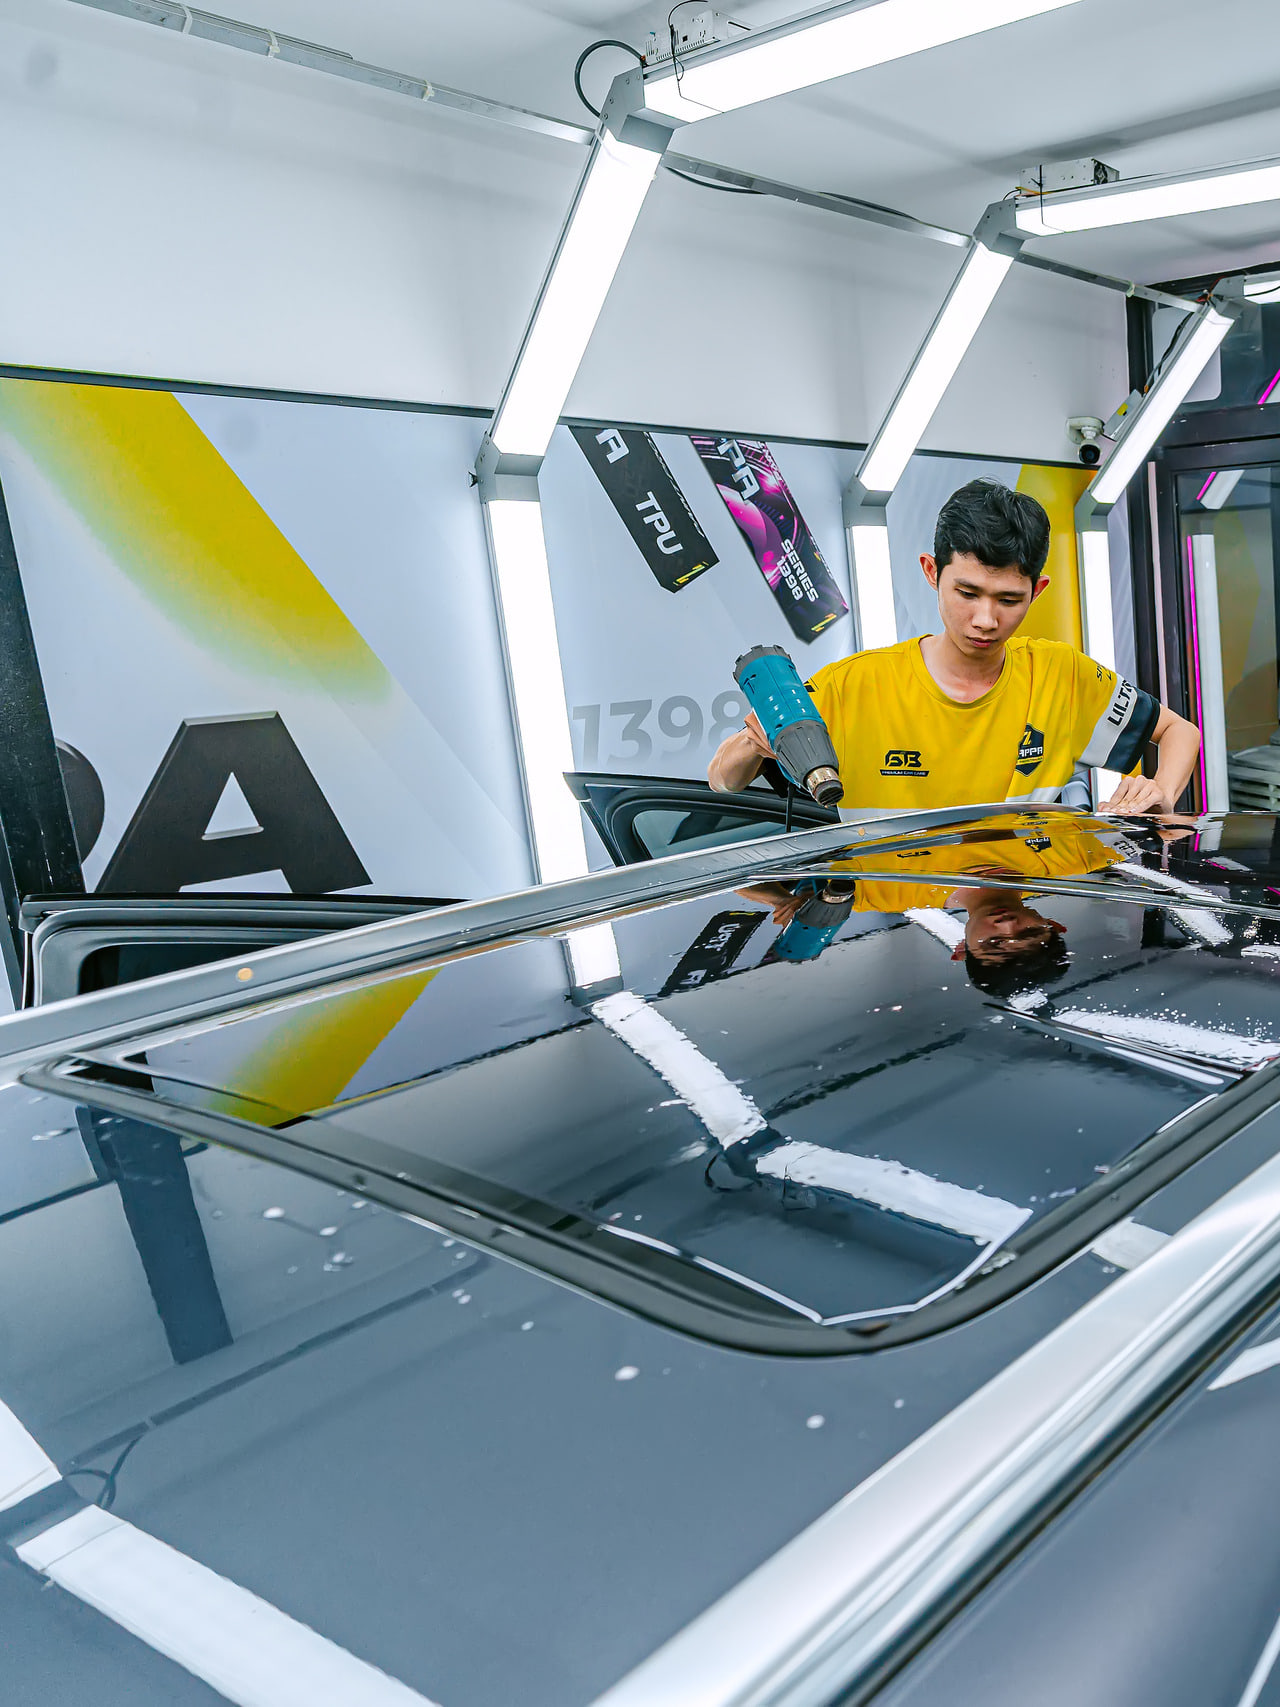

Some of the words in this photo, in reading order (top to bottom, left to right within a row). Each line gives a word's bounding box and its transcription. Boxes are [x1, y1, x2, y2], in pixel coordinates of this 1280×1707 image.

[717, 438, 760, 500] PA
[635, 491, 684, 555] TPU
[776, 555, 803, 600] 1398
[781, 538, 819, 602] SERIES
[572, 690, 752, 768] 1398
[54, 711, 374, 893] A
